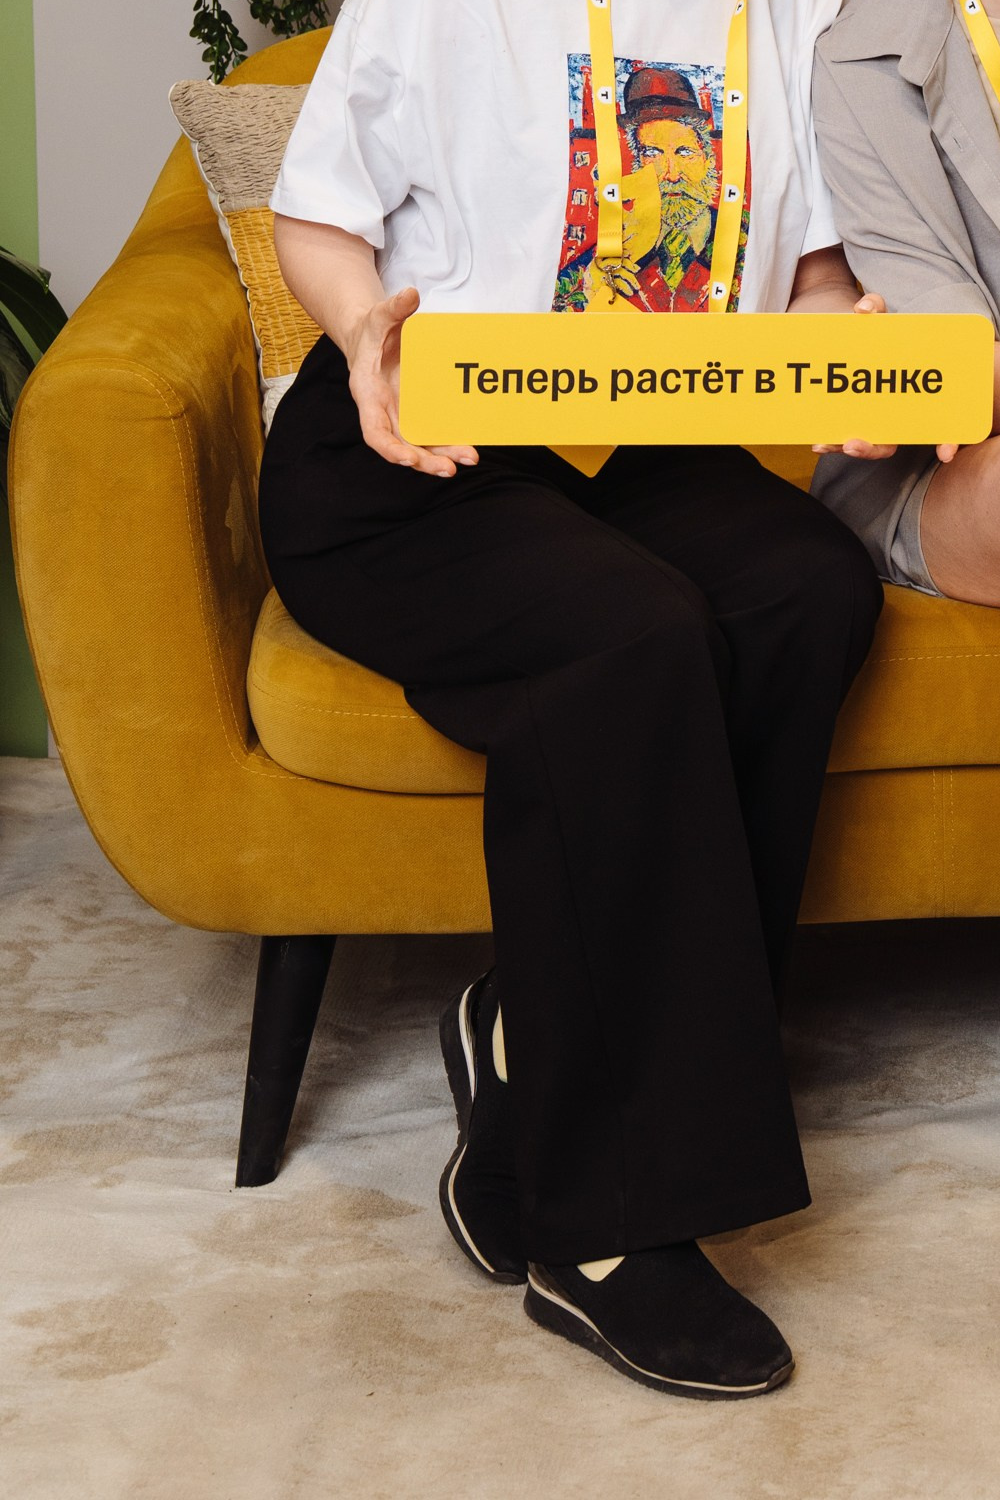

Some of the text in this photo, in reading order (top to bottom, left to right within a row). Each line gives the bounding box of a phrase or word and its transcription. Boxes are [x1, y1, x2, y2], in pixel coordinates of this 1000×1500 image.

[454, 361, 943, 402] Теперь растёт в Т-Банке
